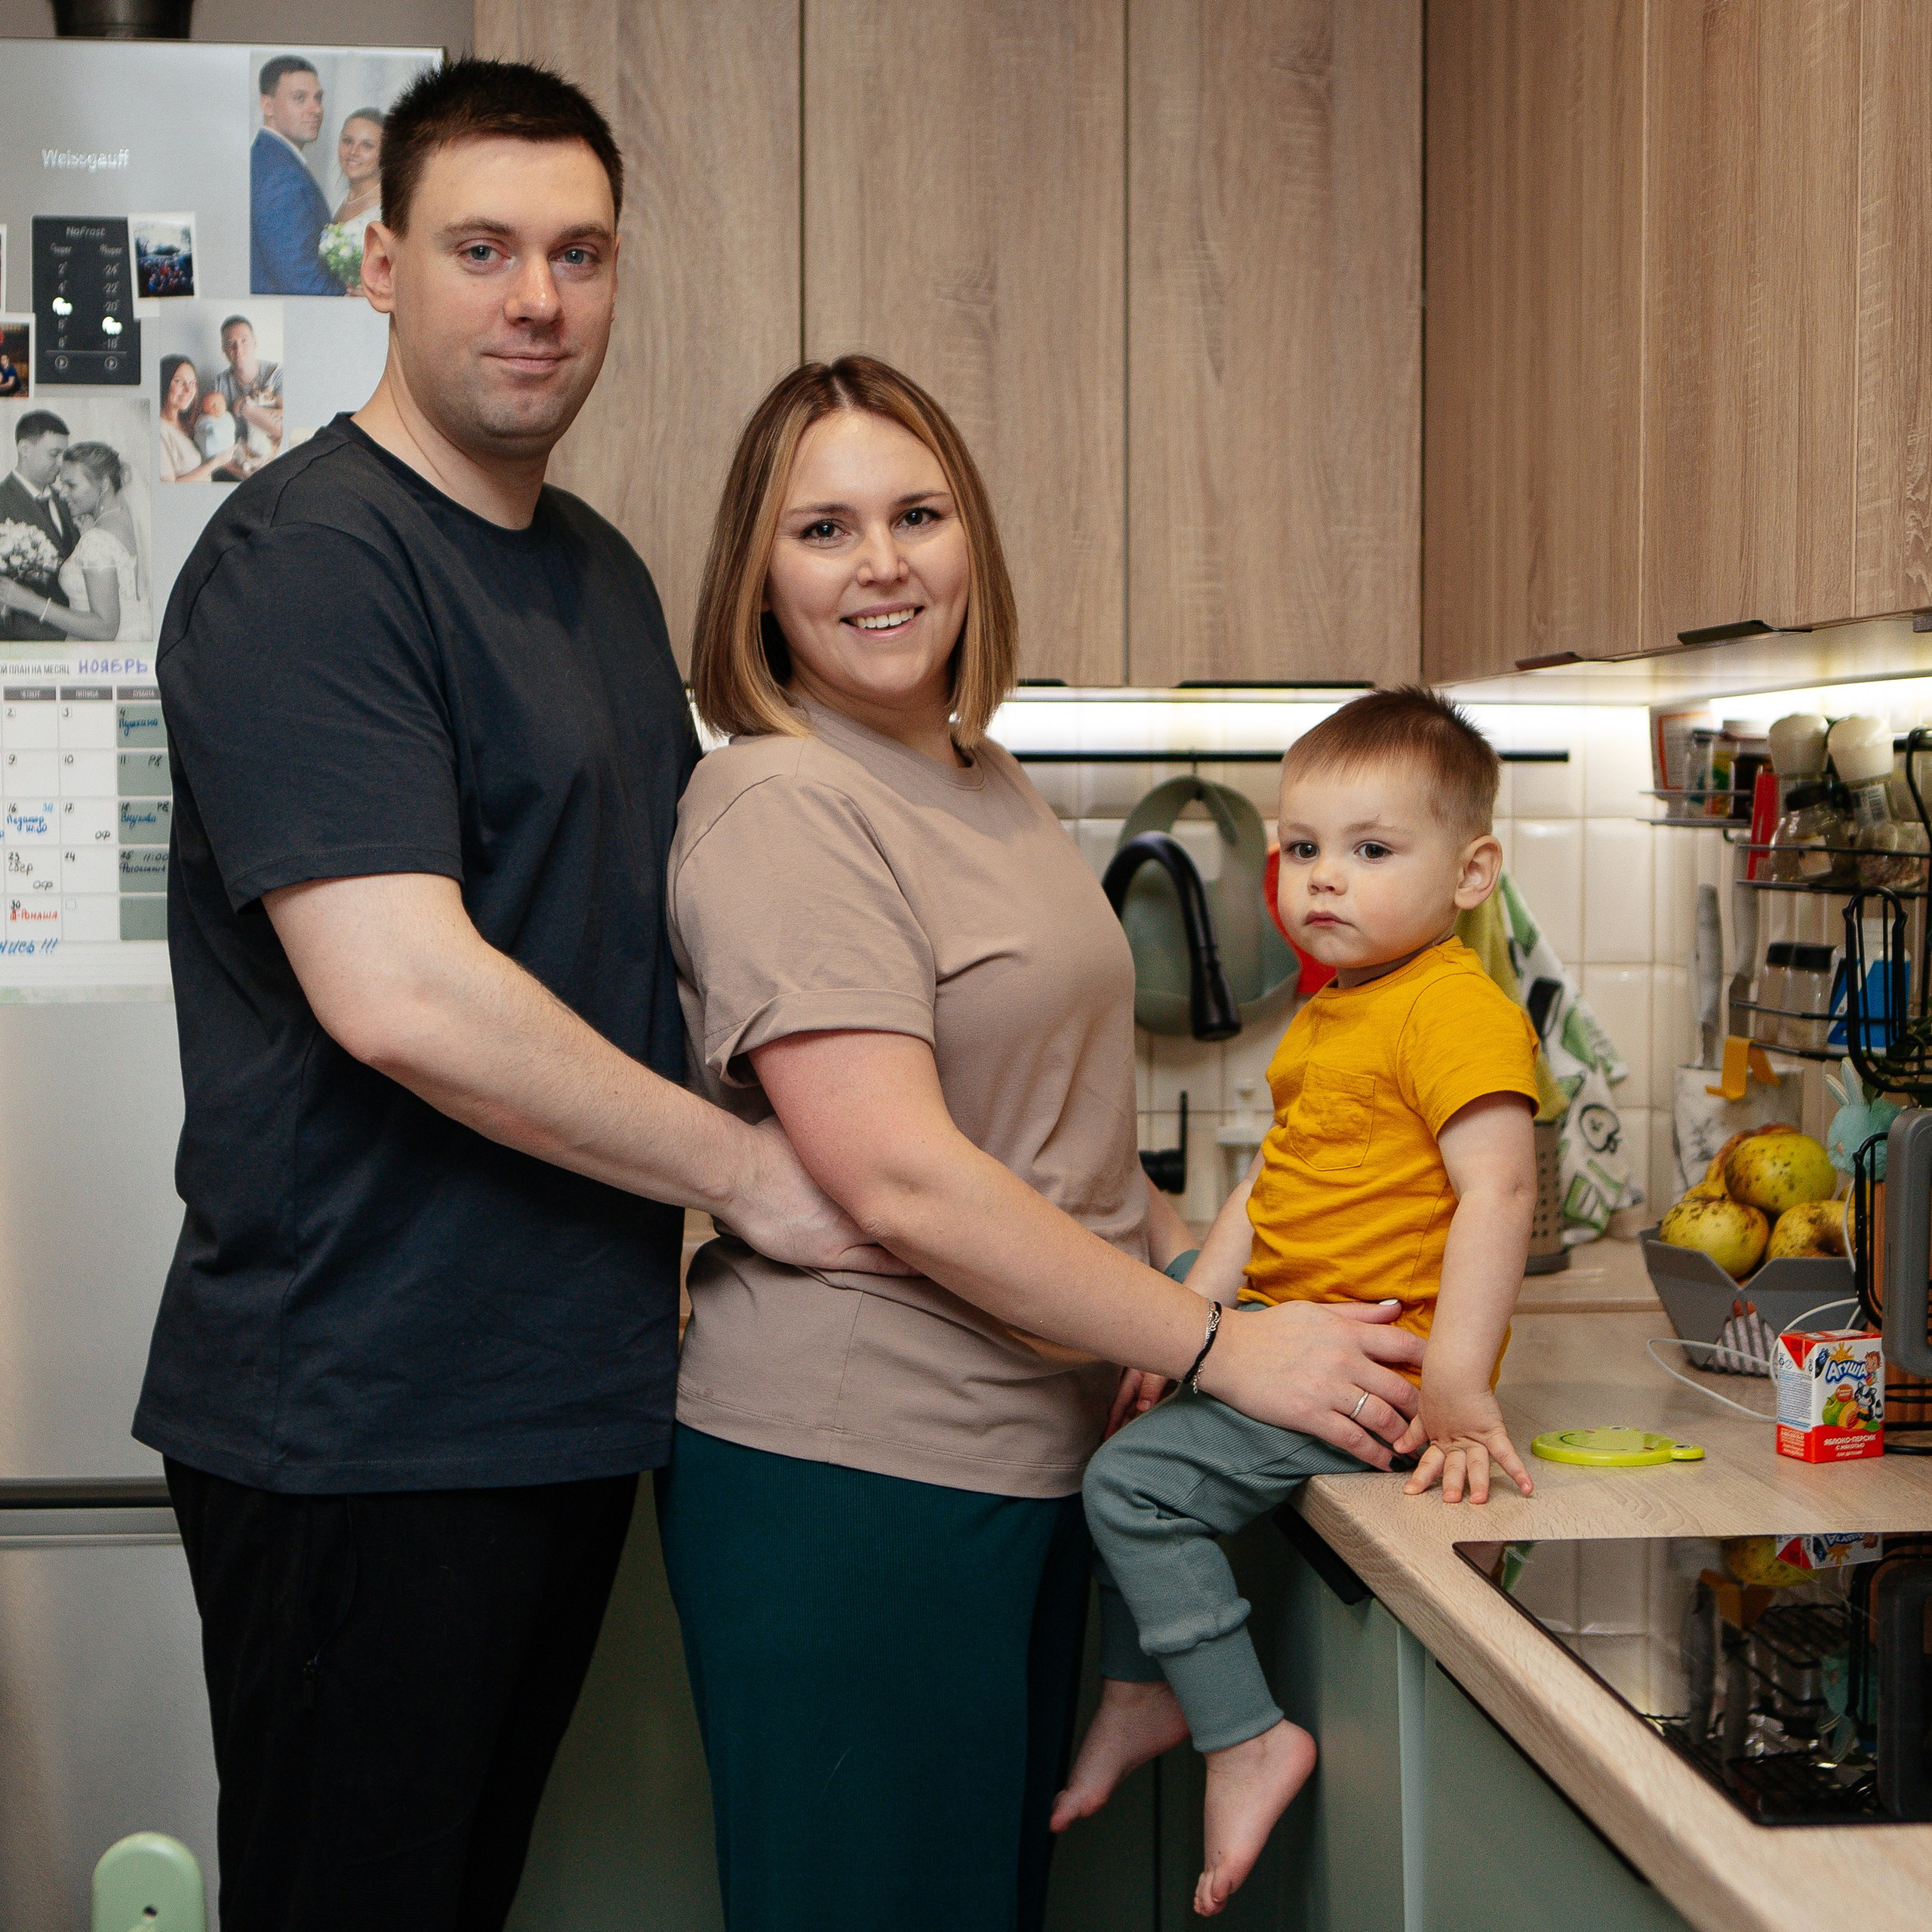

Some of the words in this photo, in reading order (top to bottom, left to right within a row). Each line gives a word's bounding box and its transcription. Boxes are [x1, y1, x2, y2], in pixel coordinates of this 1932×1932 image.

[9, 665, 30, 674] ПЛАН
[32, 665, 42, 674] НА
[44, 665, 69, 675] МЕСЯЦ
[78, 659, 148, 674] НОЯБРЬ
[7, 708, 14, 718] 2
[63, 708, 69, 717] 3
[8, 754, 15, 764] 9
[64, 755, 74, 764] 10
[120, 755, 126, 765] 11
[8, 803, 17, 813] 16
[64, 803, 73, 813] 17
